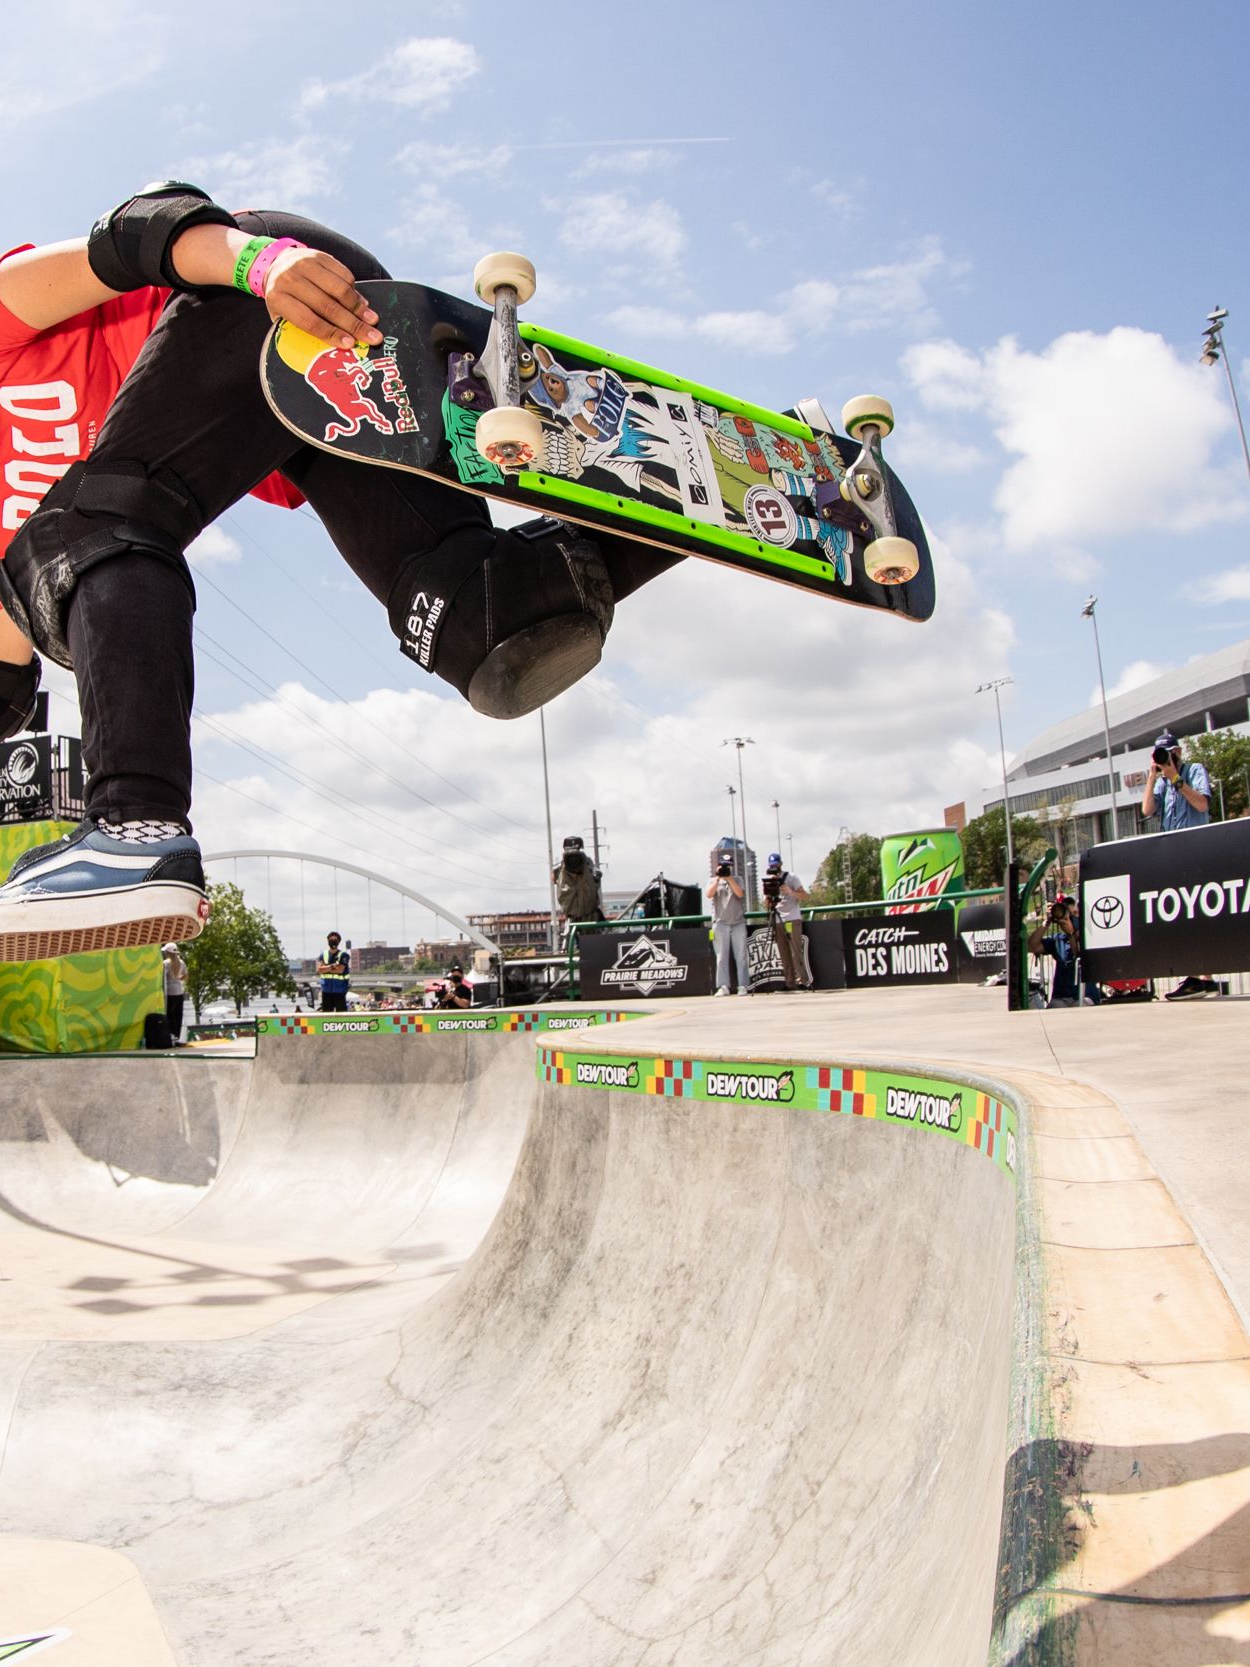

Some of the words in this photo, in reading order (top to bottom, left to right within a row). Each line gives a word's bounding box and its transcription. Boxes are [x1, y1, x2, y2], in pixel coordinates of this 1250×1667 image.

[754, 499, 787, 536] 13
[406, 592, 429, 654] 187
[425, 597, 445, 630] PADS
[419, 629, 434, 667] KILLER
[855, 926, 918, 946] CATCH
[604, 970, 638, 982] PRAIRIE
[640, 968, 684, 980] MEADOWS
[855, 947, 887, 976] DES
[891, 943, 949, 975] MOINES
